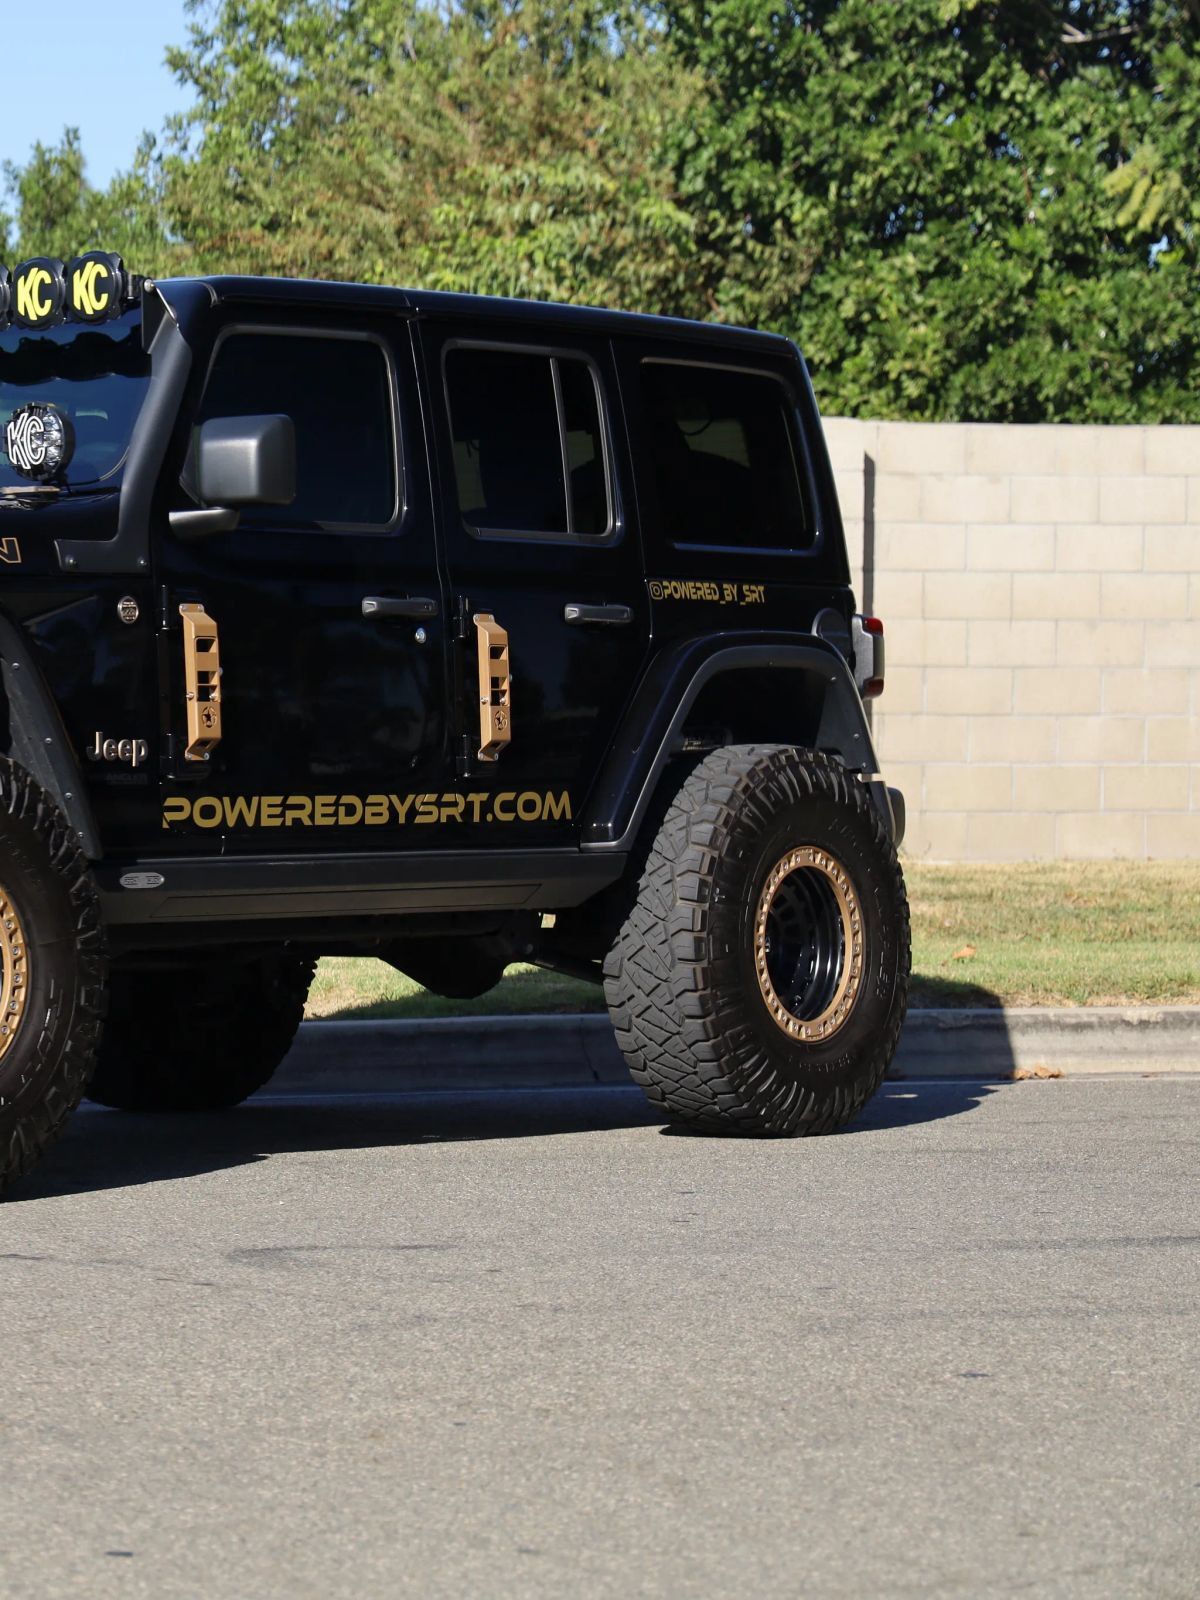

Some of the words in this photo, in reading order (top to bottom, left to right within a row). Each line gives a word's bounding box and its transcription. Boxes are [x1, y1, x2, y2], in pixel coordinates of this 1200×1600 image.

[17, 267, 52, 321] KC
[73, 261, 109, 315] KC
[6, 412, 46, 470] KC
[86, 731, 149, 767] Jeep
[162, 790, 572, 829] POWEREDBYSRT.COM
